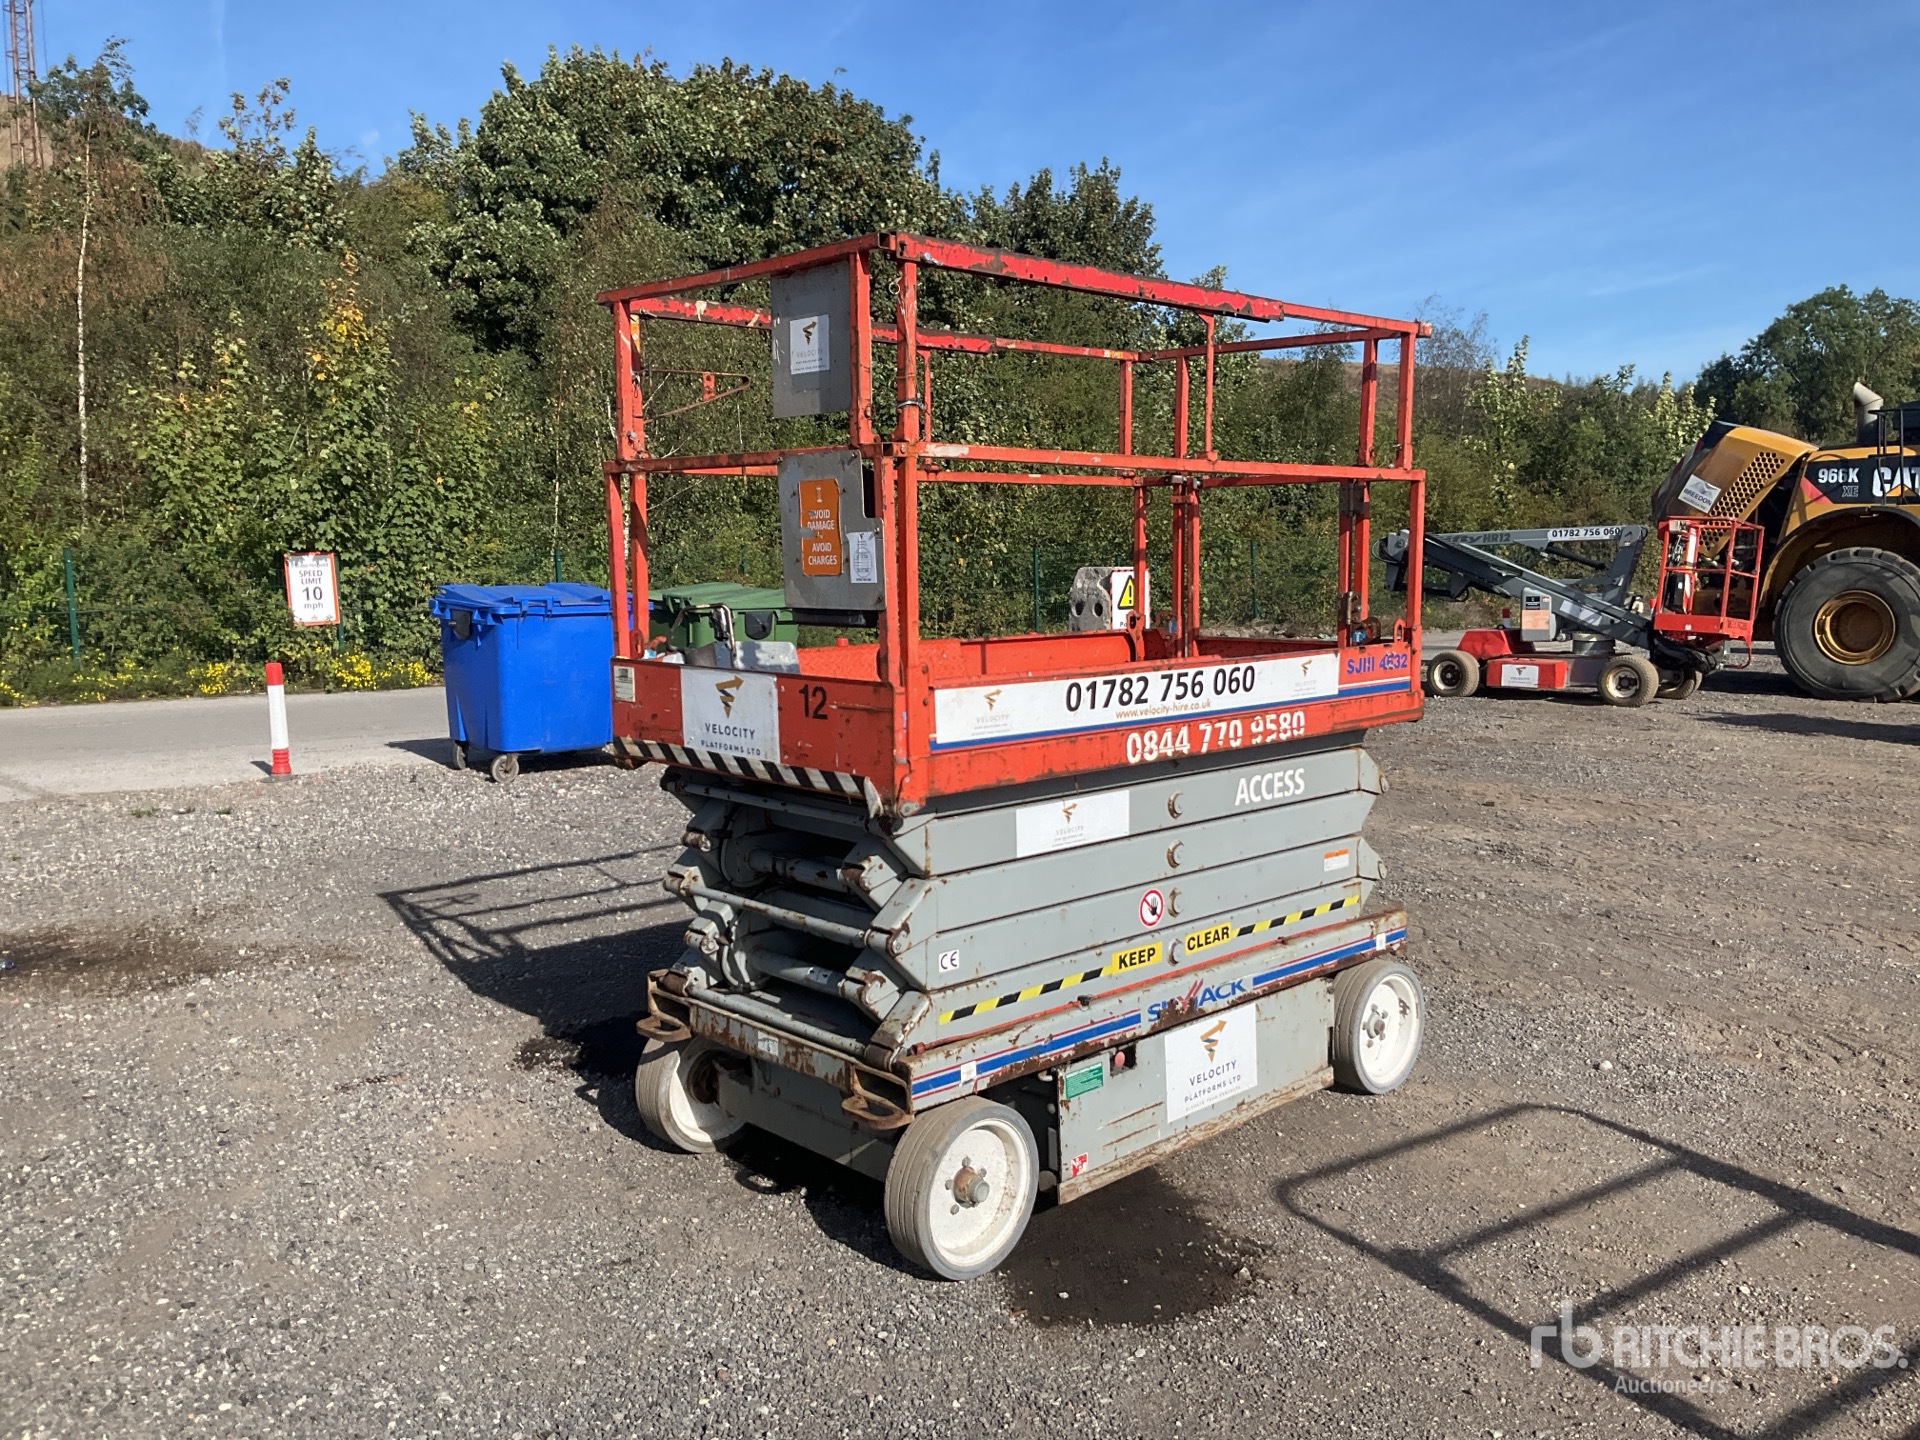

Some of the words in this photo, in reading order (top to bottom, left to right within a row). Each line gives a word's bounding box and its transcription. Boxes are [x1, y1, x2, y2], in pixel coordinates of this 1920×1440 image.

[1818, 467, 1860, 483] 966K
[1683, 488, 1712, 506] BREEDON
[1841, 485, 1859, 498] XE
[807, 520, 835, 531] DAMAGE
[1551, 529, 1580, 538] 01782
[1583, 528, 1600, 537] 756
[1603, 527, 1621, 536] 060
[812, 542, 832, 552] AVOID
[1483, 533, 1511, 544] HR12
[808, 555, 838, 565] CHARGES
[298, 569, 323, 578] SPEED
[301, 577, 322, 585] LIMIT
[302, 586, 323, 601] 10
[304, 601, 324, 610] mph
[1065, 674, 1150, 712] 01782
[1160, 670, 1204, 702] 756
[1212, 665, 1256, 697] 060
[798, 683, 829, 720] 12
[1115, 698, 1212, 720] www.velocity-hire.co.uk
[705, 723, 756, 740] VELOCITY
[701, 739, 745, 753] PLATFORMS
[747, 747, 761, 756] LTD
[1125, 723, 1191, 764] 0844
[1198, 718, 1243, 754] 770
[1234, 767, 1306, 806] ACCESS
[1118, 946, 1156, 970] KEEP
[1187, 925, 1230, 952] CLEAR
[940, 951, 958, 970] CE
[1189, 1060, 1237, 1087] VELOCITY
[1184, 1081, 1227, 1103] PLATFORMS
[1229, 1074, 1241, 1085] LTD
